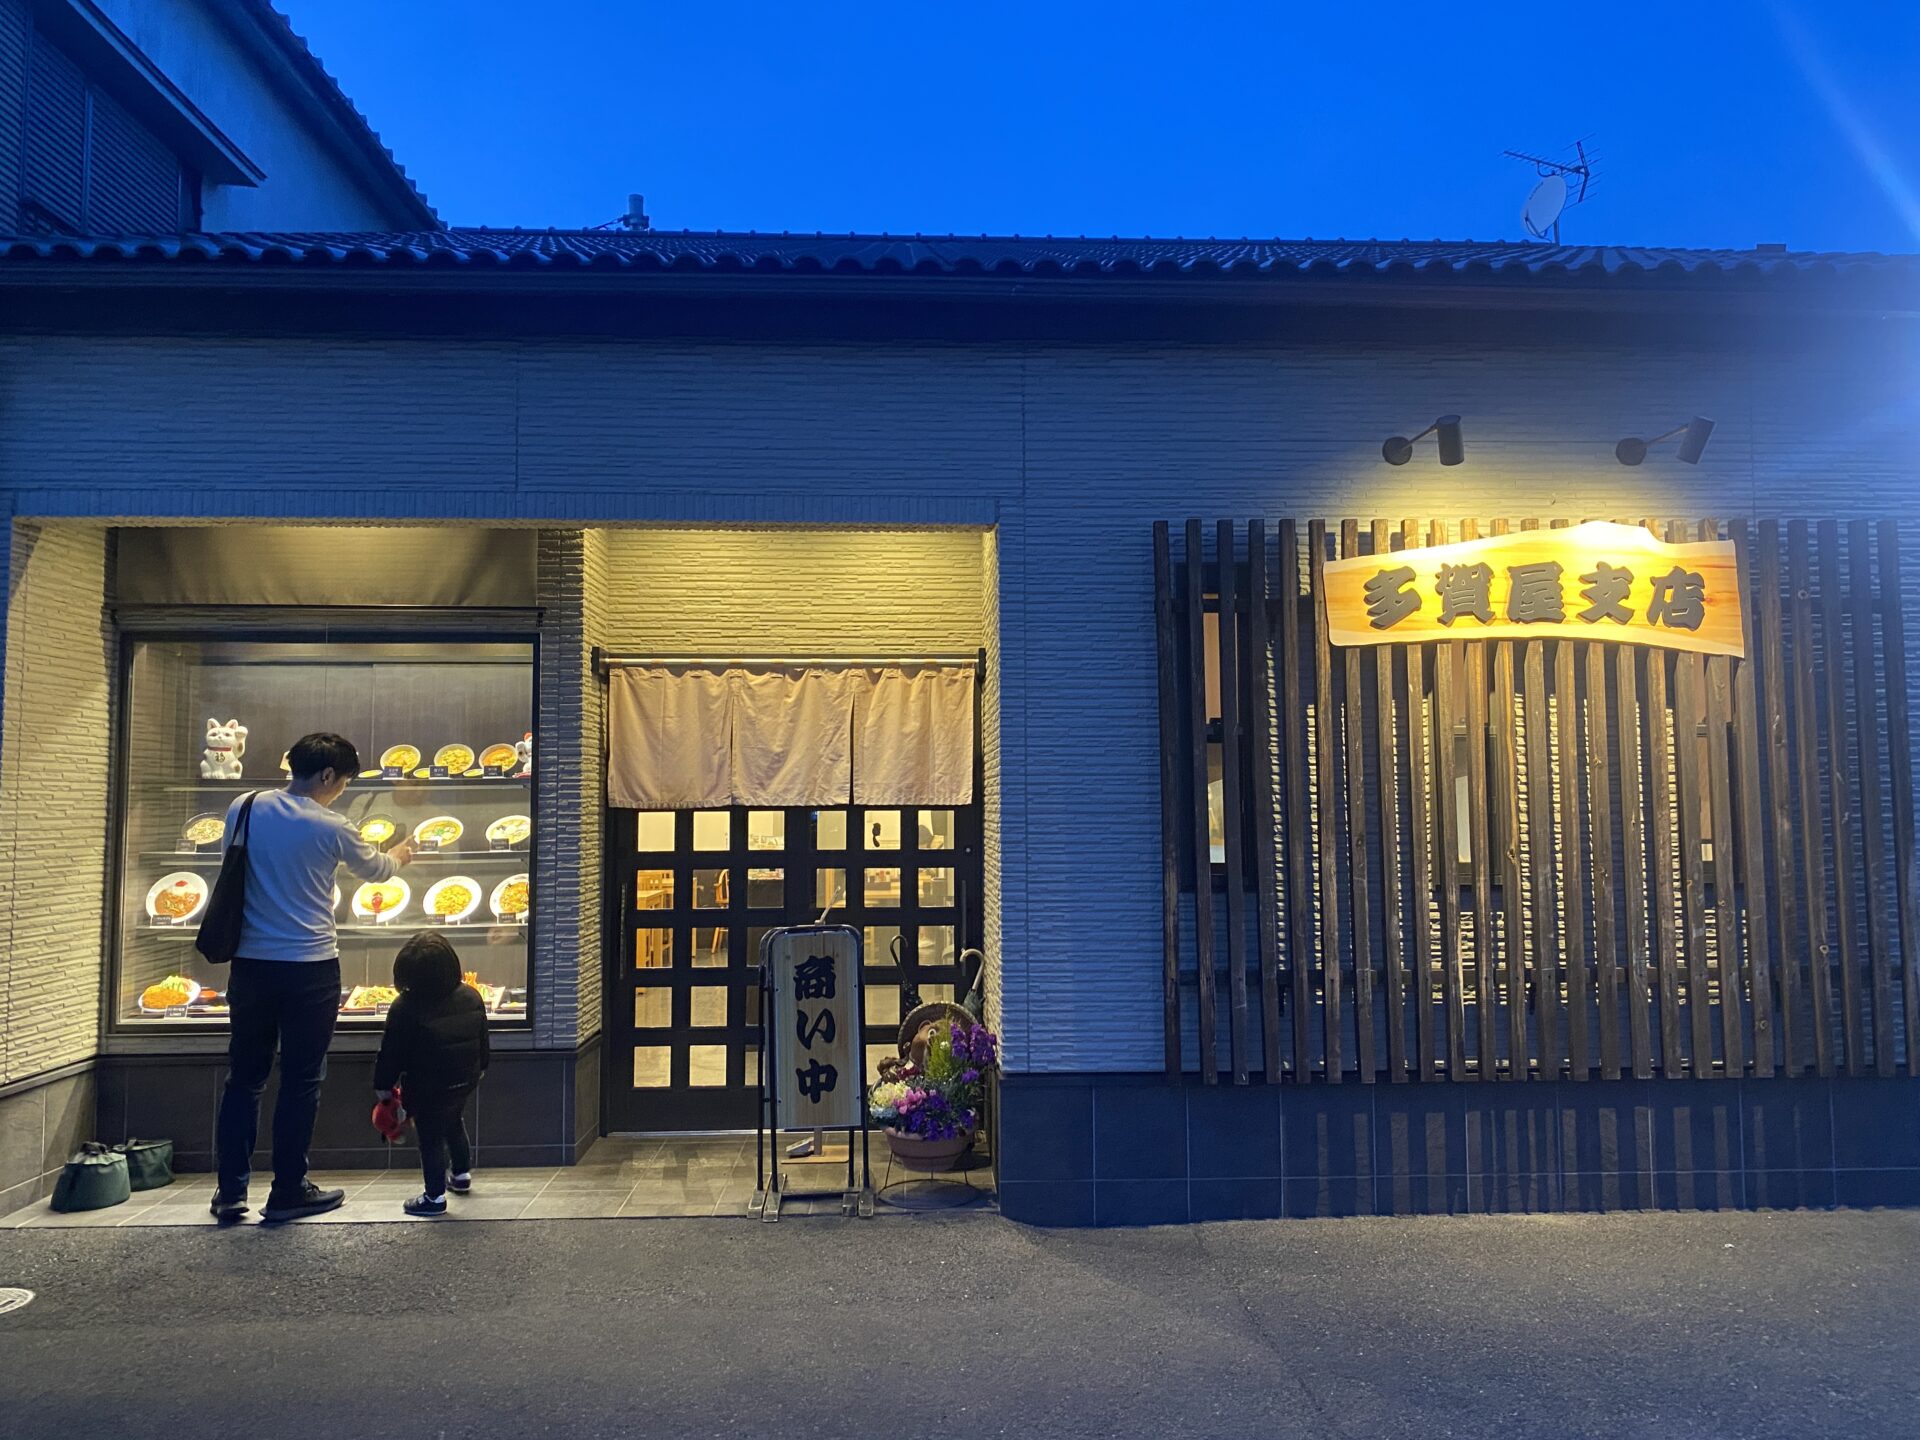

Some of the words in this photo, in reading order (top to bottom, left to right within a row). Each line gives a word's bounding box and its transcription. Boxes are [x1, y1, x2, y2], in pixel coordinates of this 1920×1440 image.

[1363, 560, 1706, 632] 多賀屋支店
[793, 955, 838, 1104] 商い中
